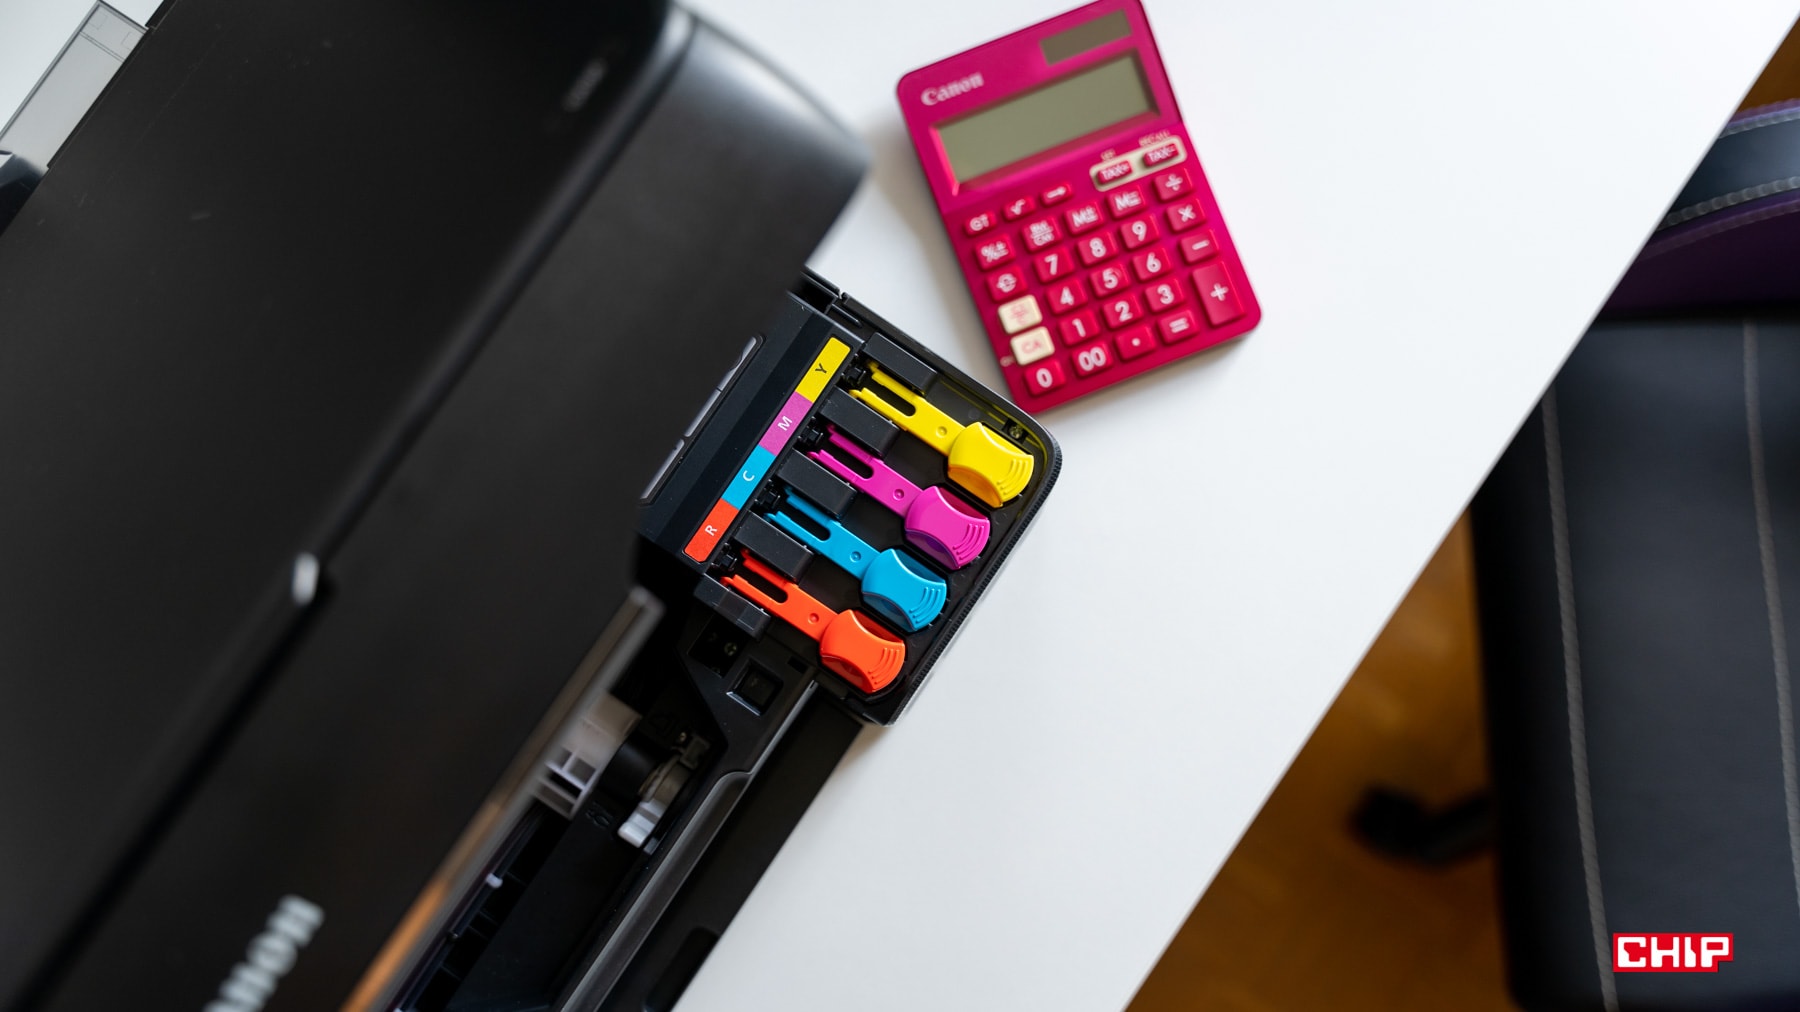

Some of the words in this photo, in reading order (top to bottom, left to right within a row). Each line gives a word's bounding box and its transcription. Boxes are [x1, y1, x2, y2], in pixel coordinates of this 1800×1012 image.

[920, 72, 984, 106] Canon
[1131, 220, 1148, 241] 9
[1089, 237, 1107, 258] 8
[1044, 253, 1059, 275] 7
[1146, 252, 1162, 273] 6
[1102, 267, 1119, 289] 5
[1060, 286, 1075, 306] 4
[1157, 284, 1175, 304] 3
[1115, 300, 1133, 321] 2
[1071, 318, 1087, 338] 1
[815, 362, 828, 375] Y
[1078, 346, 1106, 372] 00
[1036, 367, 1053, 388] 0
[777, 415, 793, 431] M
[742, 470, 755, 482] C
[704, 524, 718, 537] R
